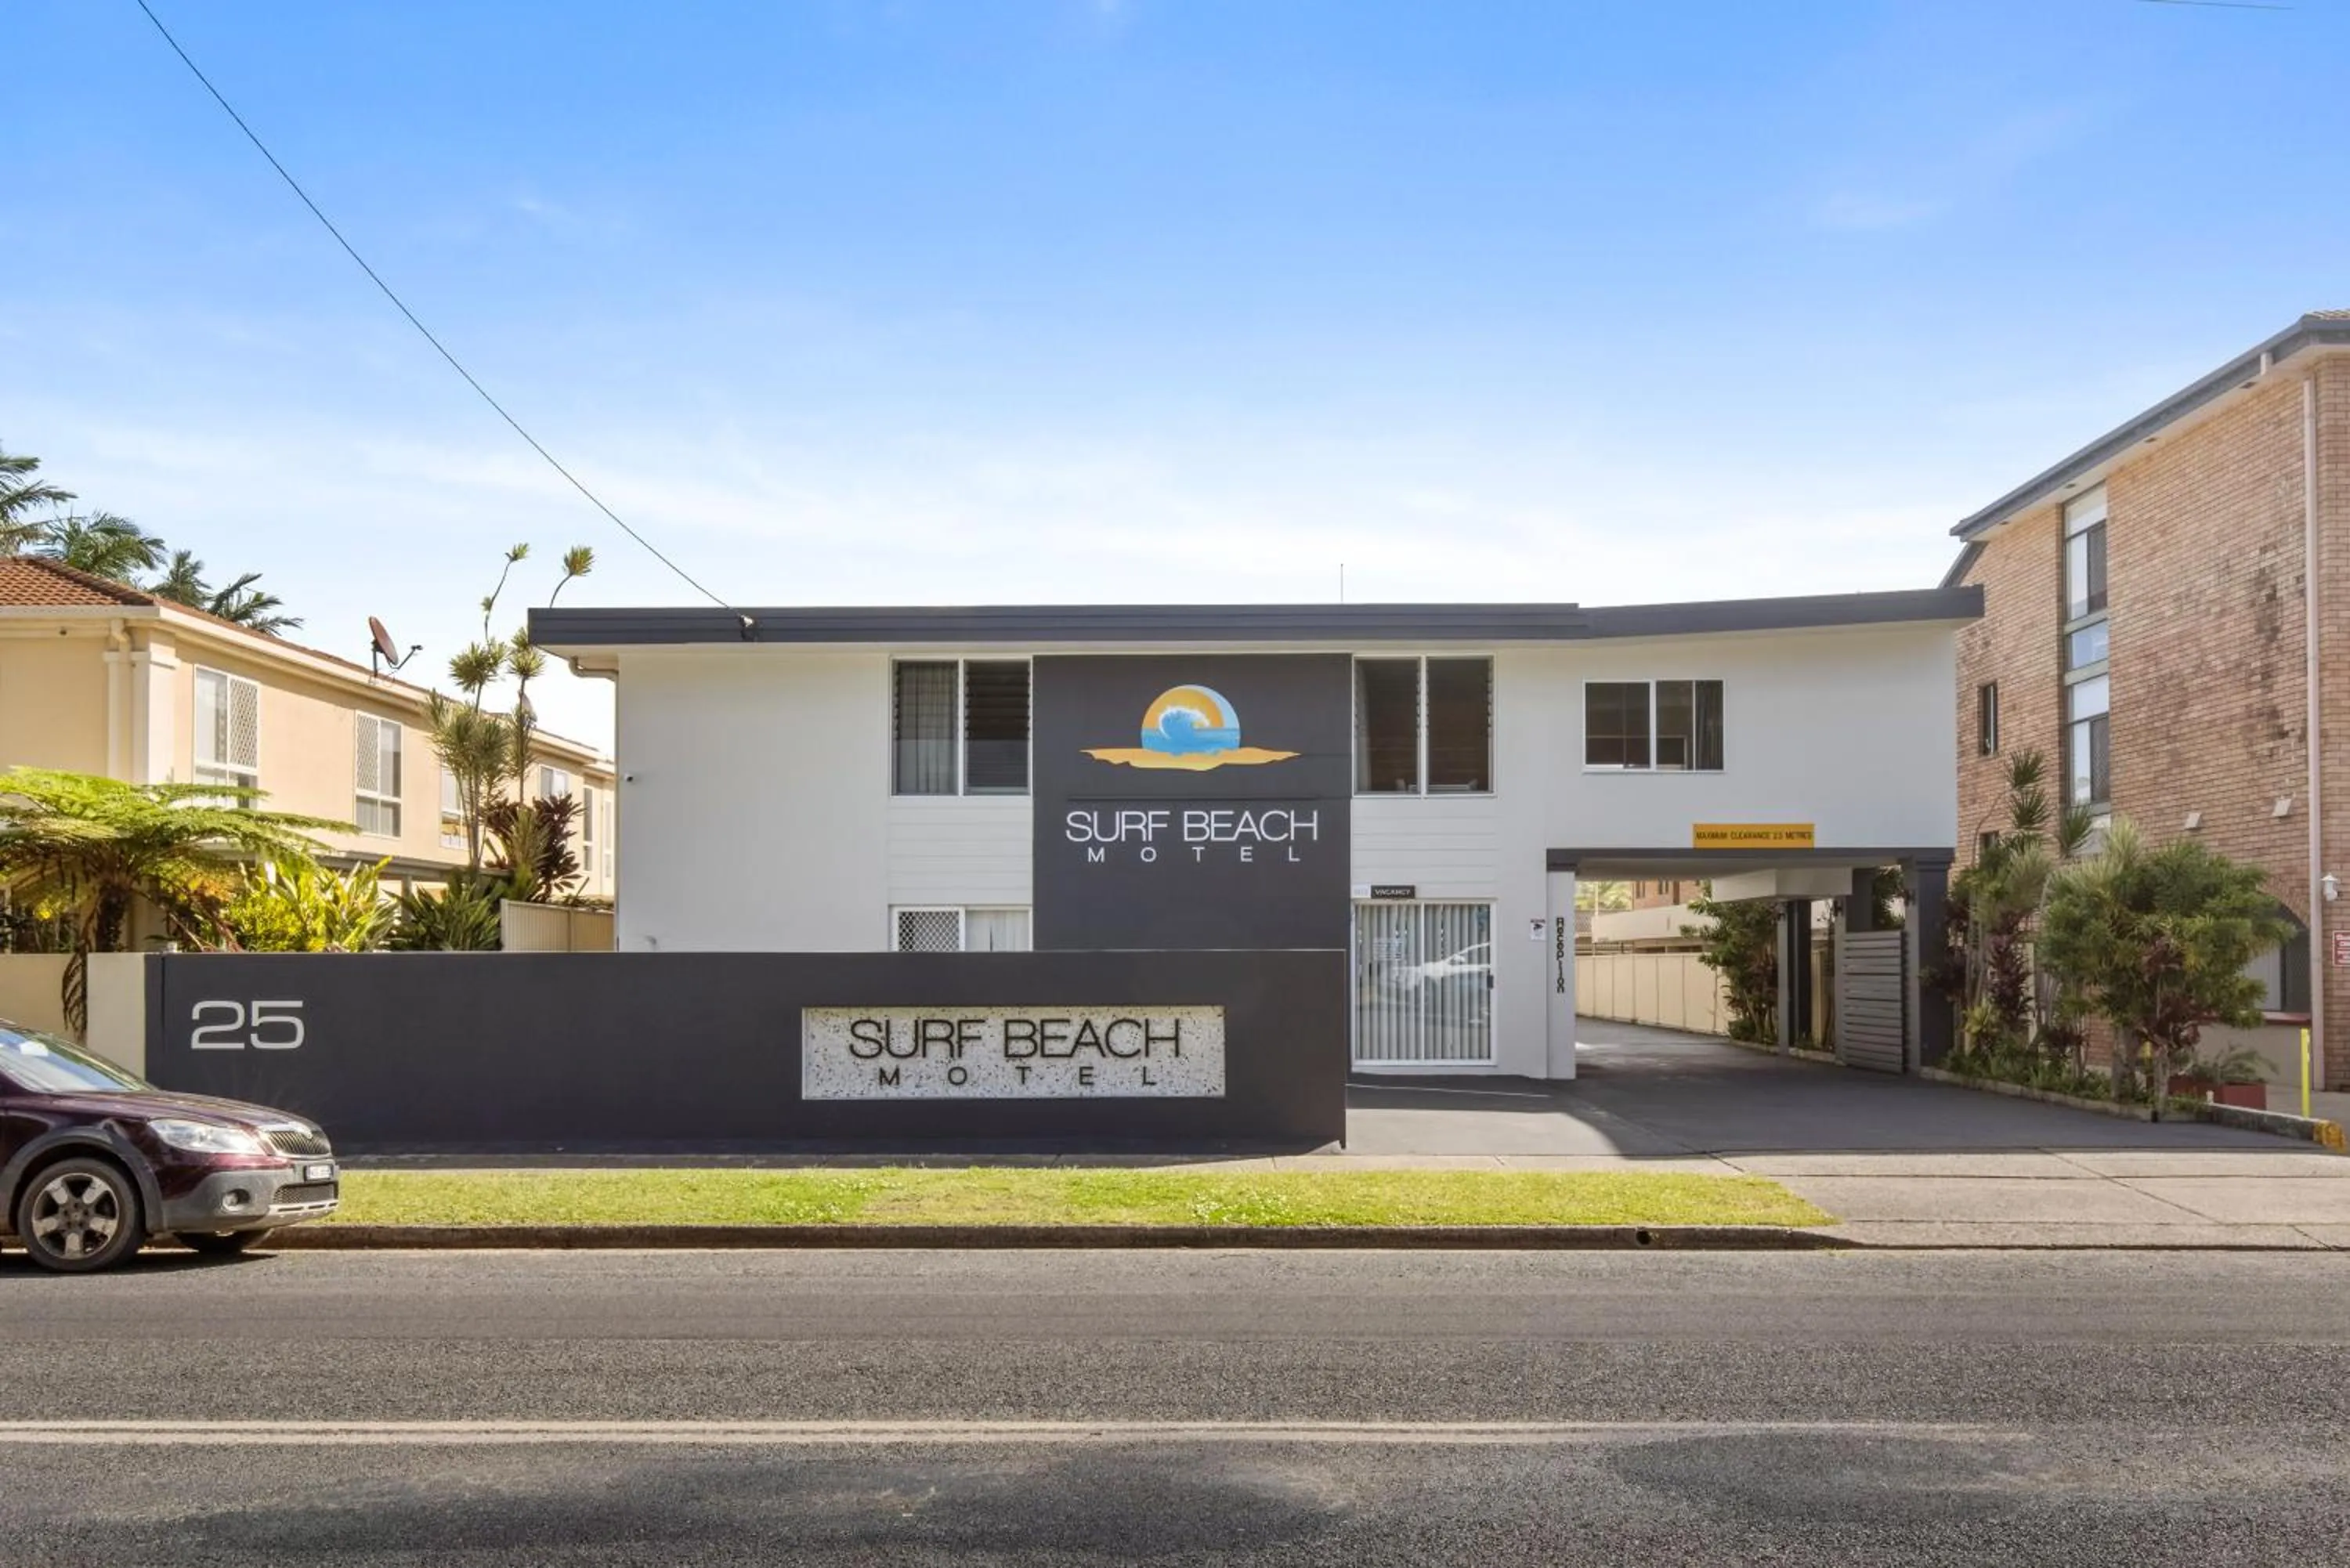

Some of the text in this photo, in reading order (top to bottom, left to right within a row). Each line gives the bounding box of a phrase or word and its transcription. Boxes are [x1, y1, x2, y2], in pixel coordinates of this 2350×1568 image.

[1066, 810, 1318, 842] SURF BEACH
[1730, 831, 1770, 840] CLEARANCE
[1088, 847, 1300, 862] MOTEL
[191, 1000, 305, 1050] 25
[849, 1019, 1180, 1058] SURF BEACH
[879, 1067, 1156, 1086] MOTEL
